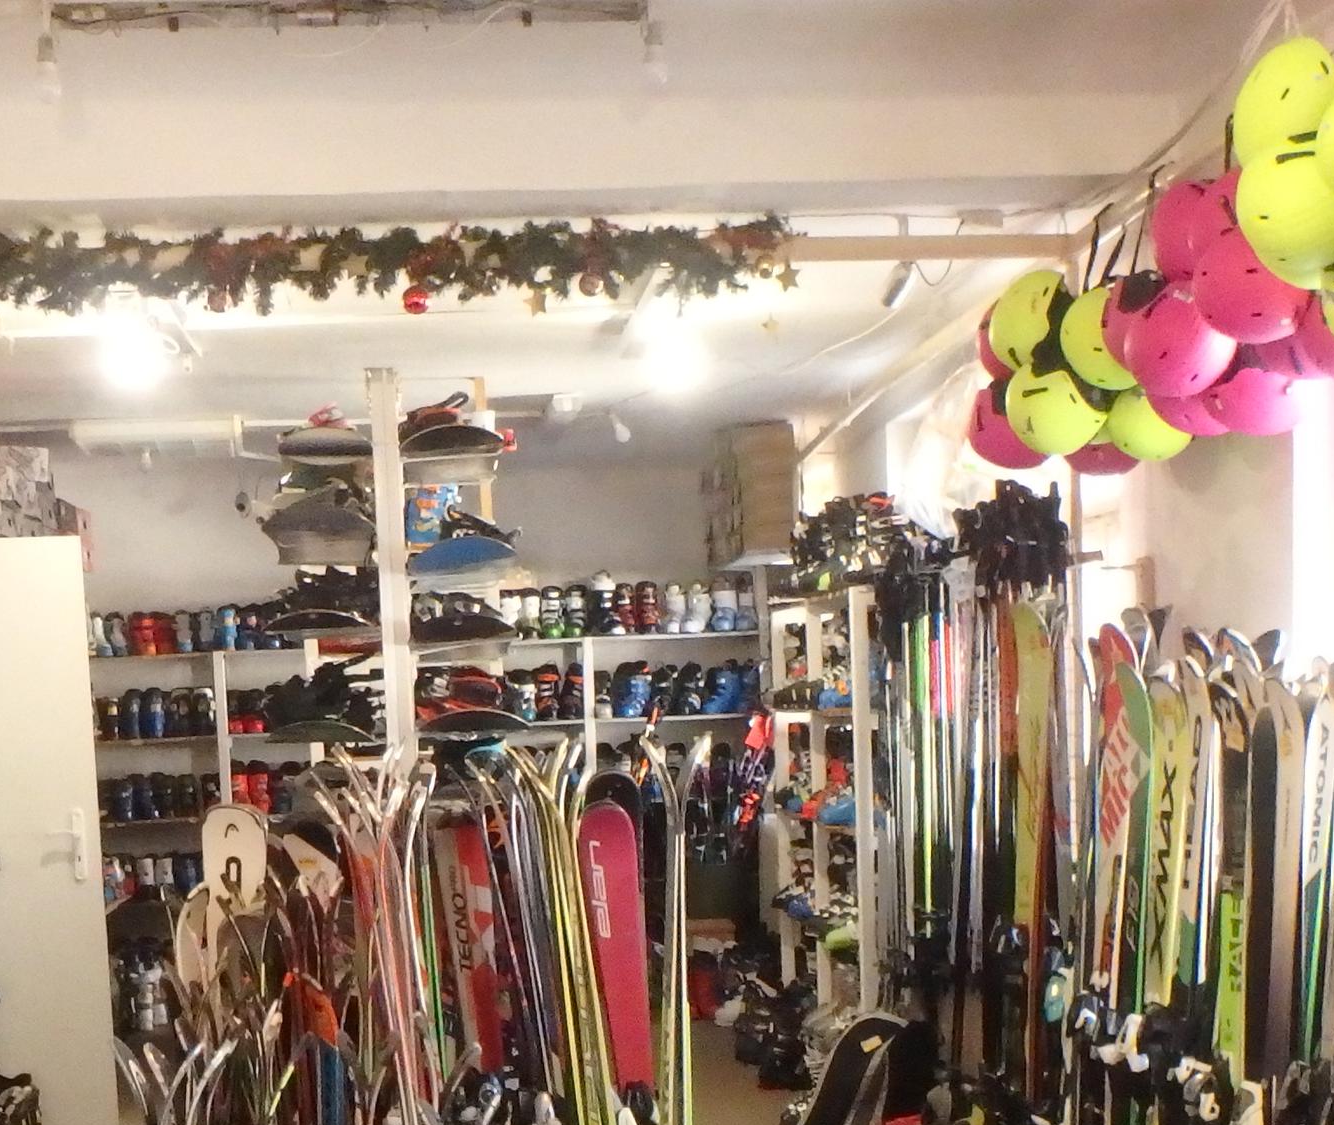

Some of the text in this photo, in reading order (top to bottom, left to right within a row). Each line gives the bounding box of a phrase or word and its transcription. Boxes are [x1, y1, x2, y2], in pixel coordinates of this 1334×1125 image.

[1307, 722, 1333, 865] ATOMIC
[588, 841, 611, 939] elan
[1149, 761, 1177, 975] XMAX
[451, 893, 472, 972] TECNO
